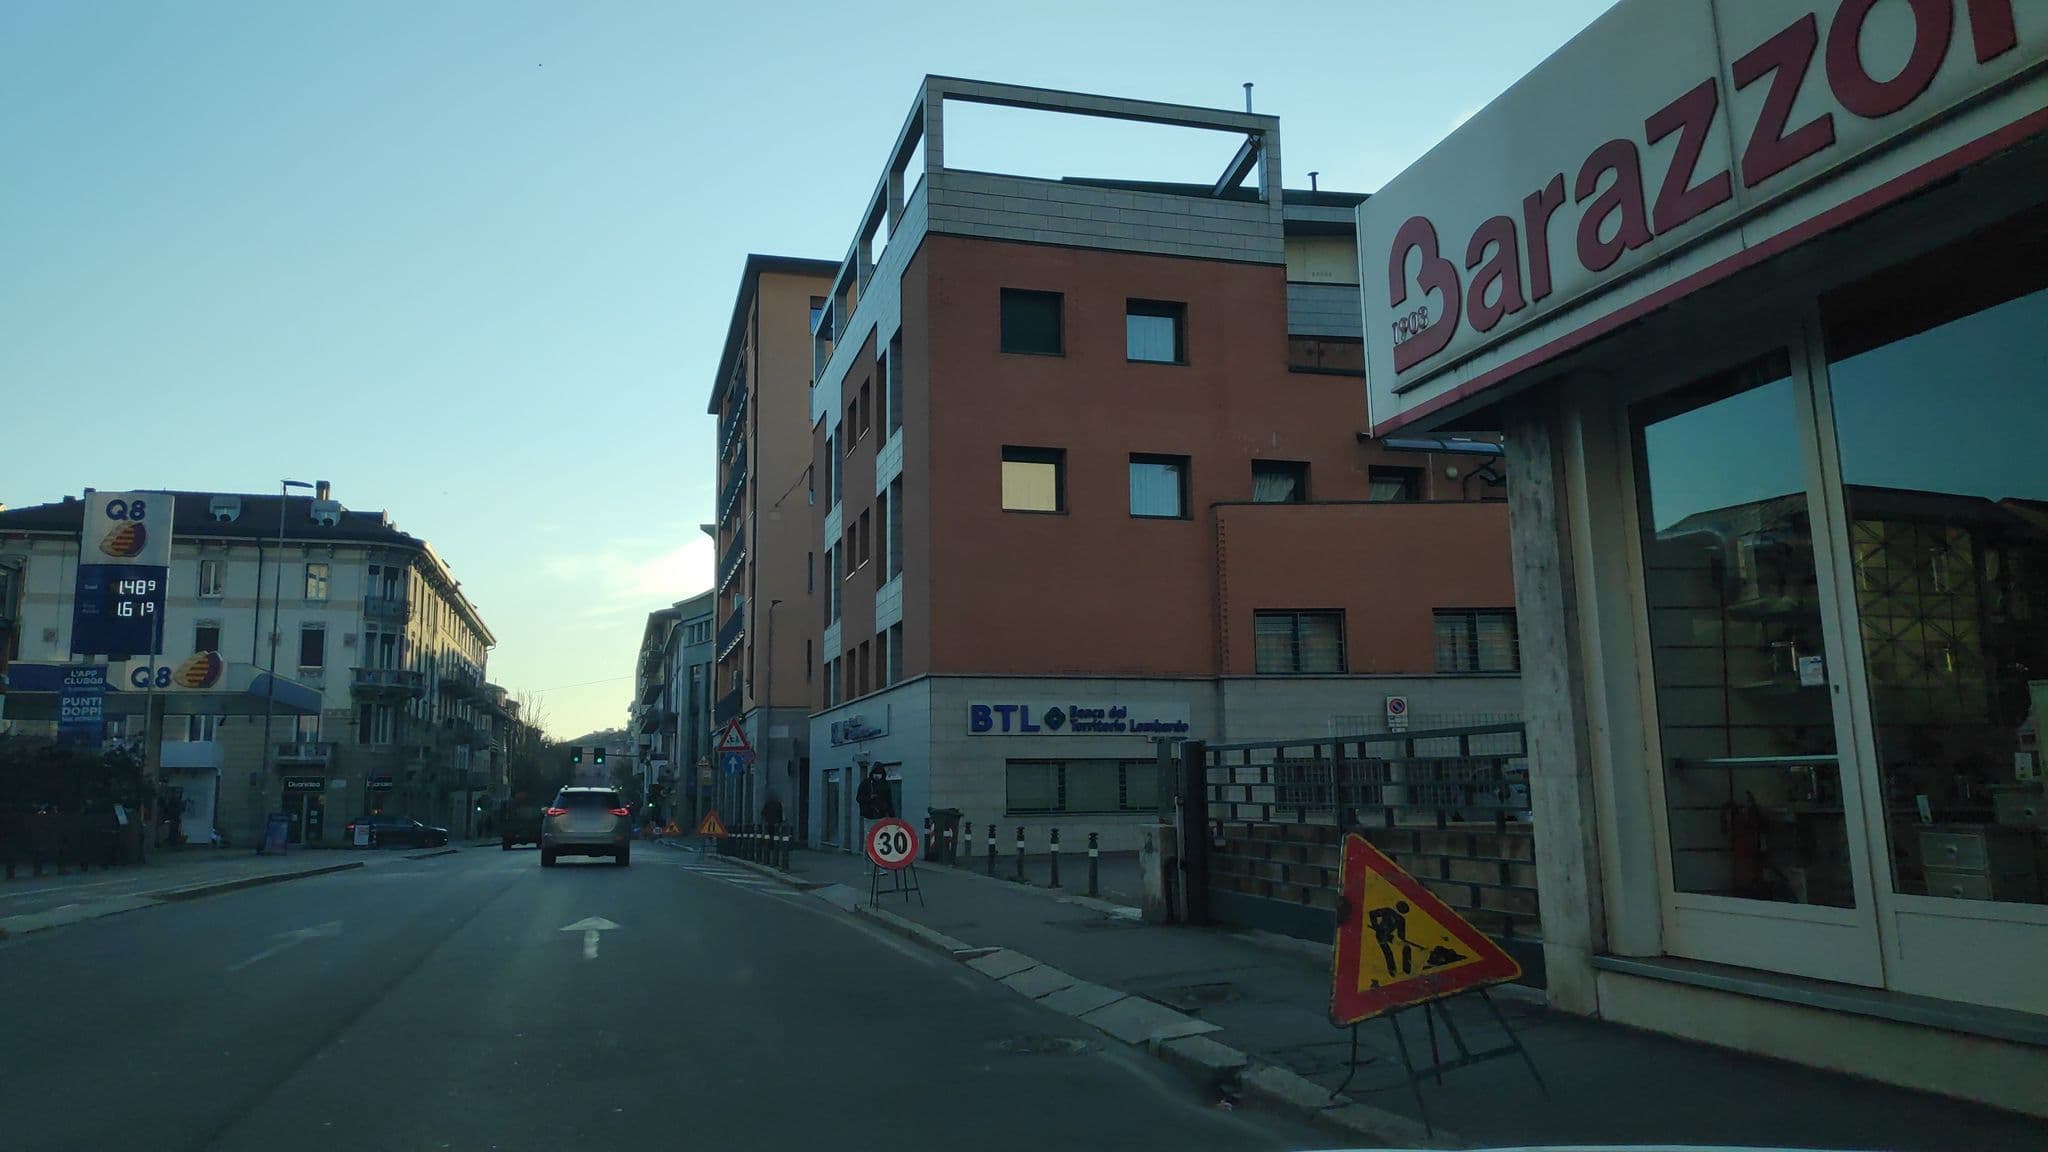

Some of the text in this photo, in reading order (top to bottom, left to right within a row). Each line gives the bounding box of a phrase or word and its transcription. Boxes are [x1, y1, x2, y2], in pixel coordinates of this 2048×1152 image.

[1388, 0, 2018, 374] Barazzo
[1392, 306, 1429, 345] 1903
[106, 499, 146, 521] Q8
[131, 666, 172, 688] Q8
[62, 697, 102, 706] PUNTI
[62, 707, 102, 716] DOPPI
[1069, 705, 1127, 719] Banca del
[971, 704, 1041, 732] BTL
[1070, 719, 1189, 732] Territorio Lombardo
[880, 831, 908, 855] 30
